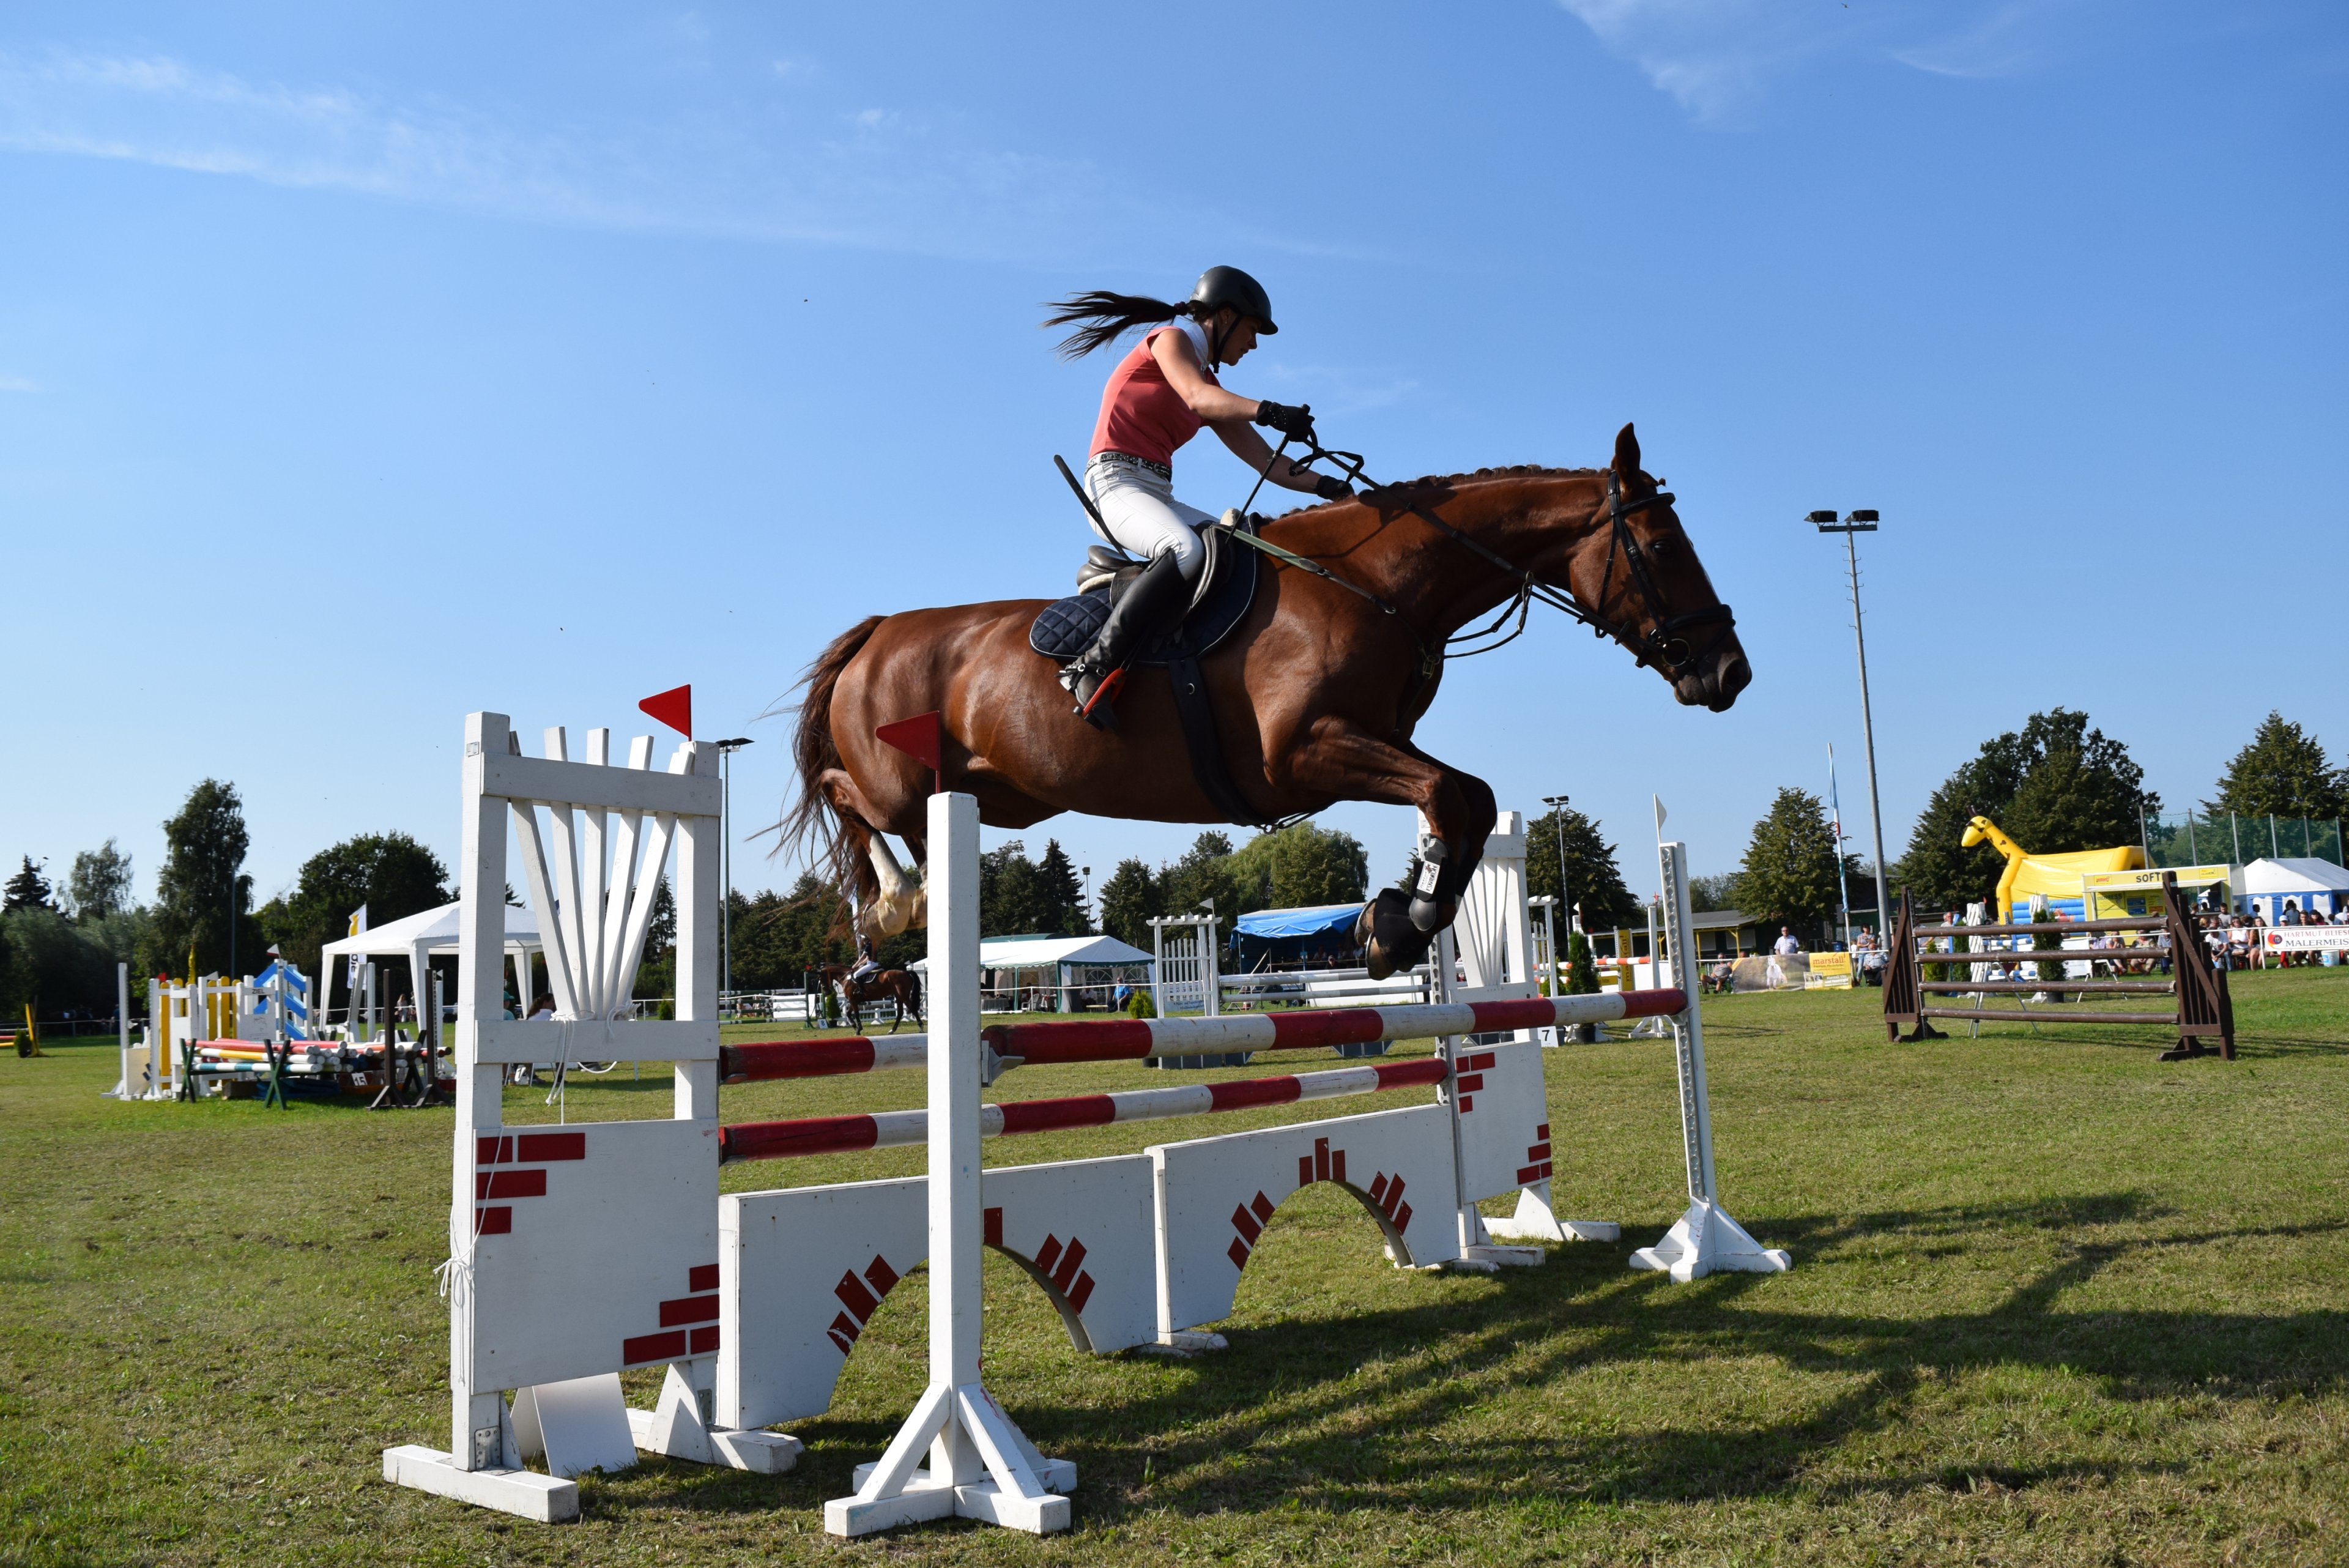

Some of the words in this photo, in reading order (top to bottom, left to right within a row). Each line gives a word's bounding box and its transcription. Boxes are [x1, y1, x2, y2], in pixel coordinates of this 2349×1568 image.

[2136, 872, 2164, 883] SOFT
[2285, 938, 2349, 947] MALERMEIS
[1542, 1030, 1549, 1041] 7
[355, 1077, 366, 1085] 15
